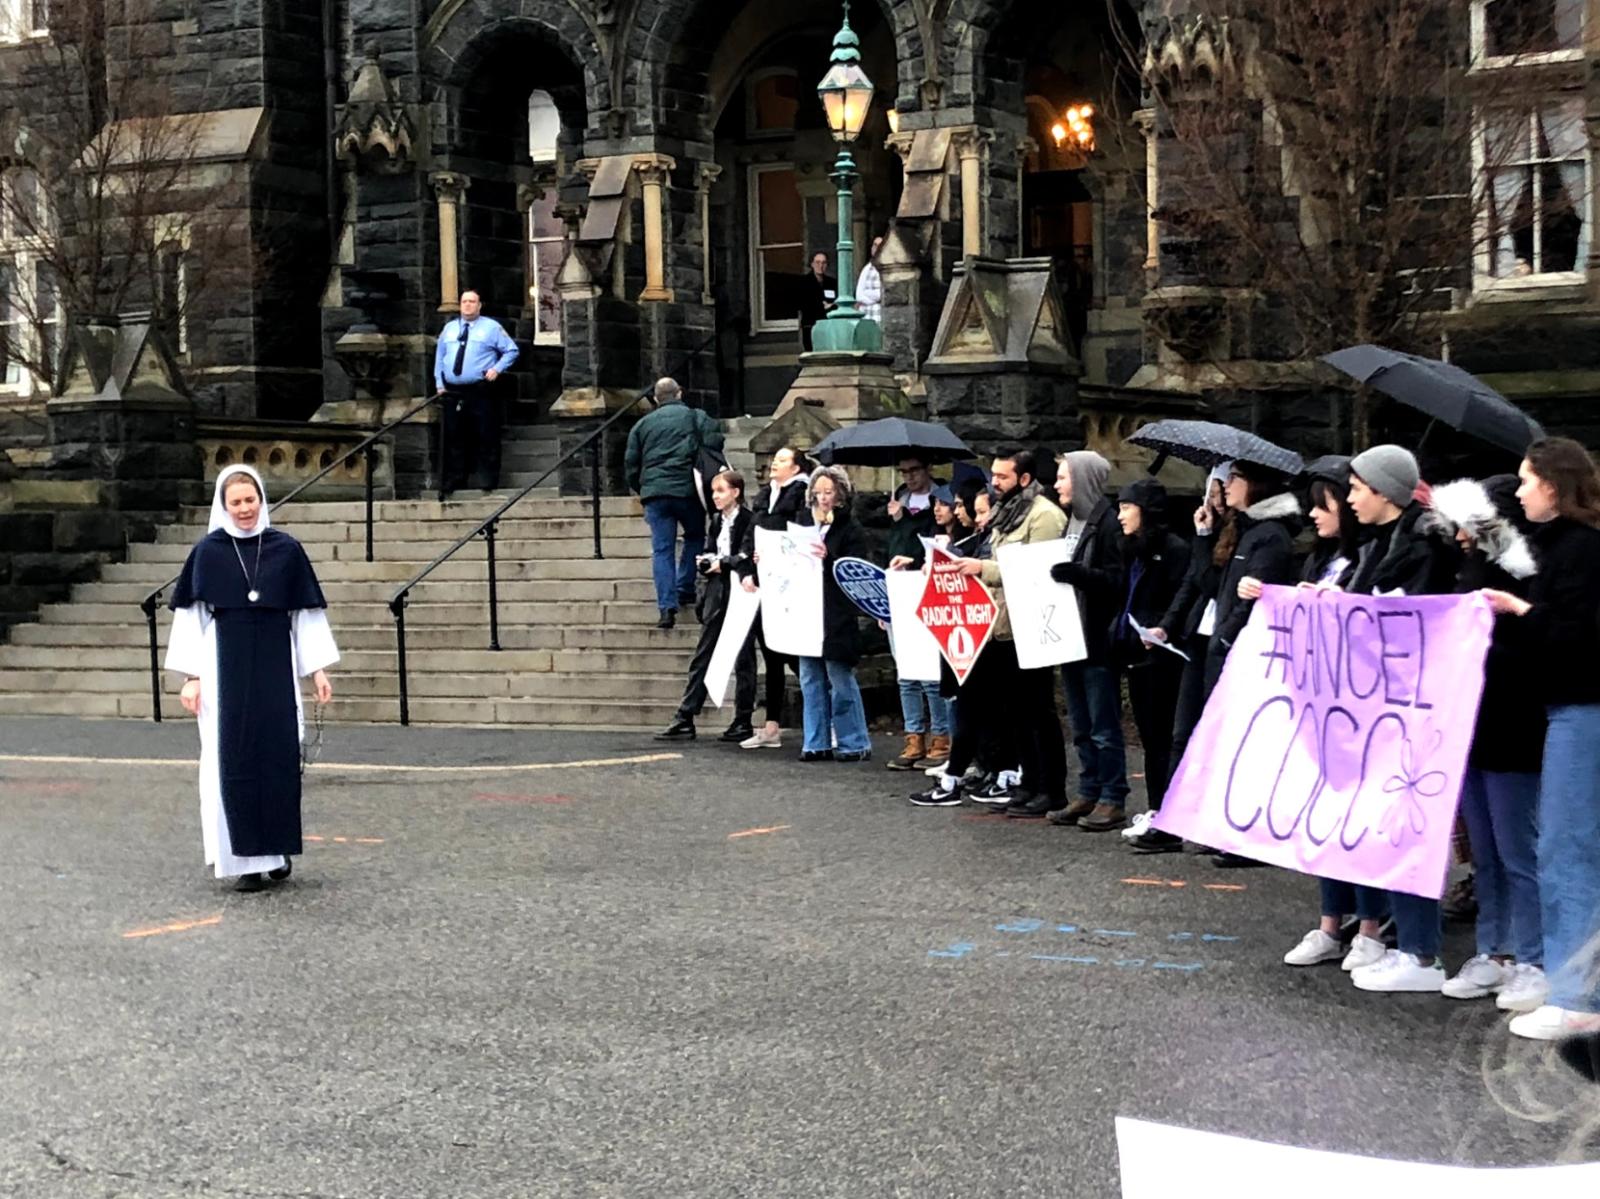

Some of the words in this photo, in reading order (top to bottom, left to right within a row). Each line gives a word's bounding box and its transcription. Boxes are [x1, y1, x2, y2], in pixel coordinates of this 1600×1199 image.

[837, 561, 876, 580] KEEP
[932, 572, 969, 594] FIGHT
[947, 594, 964, 605] THE
[921, 604, 964, 626] RADICAL
[965, 603, 992, 625] RIGHT
[1260, 602, 1433, 710] #CANCEL
